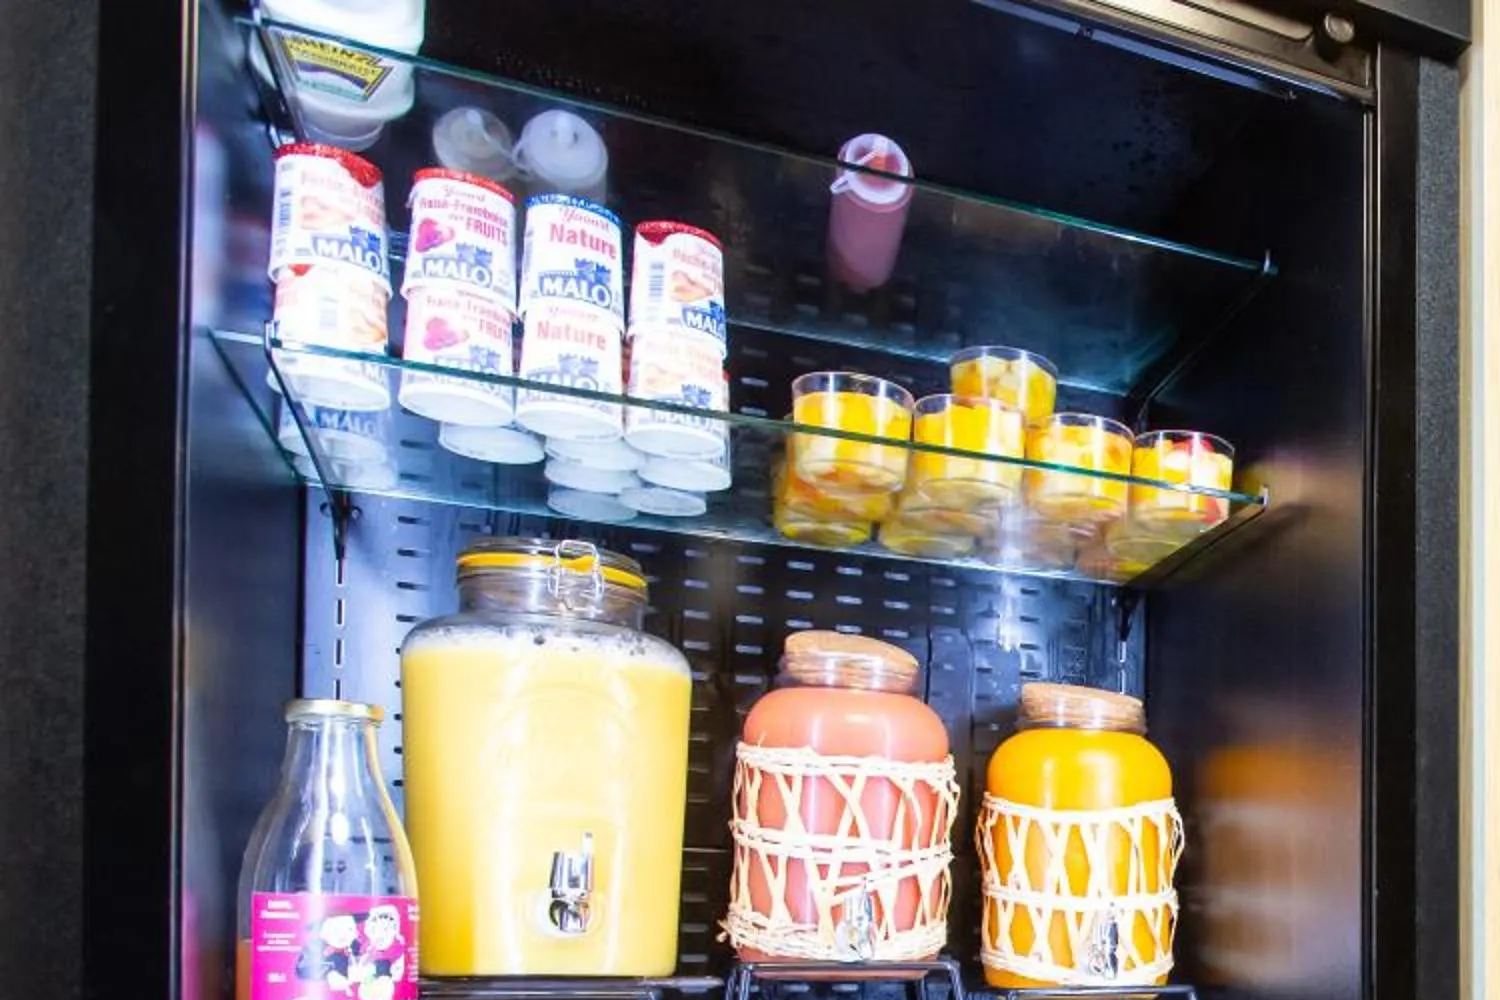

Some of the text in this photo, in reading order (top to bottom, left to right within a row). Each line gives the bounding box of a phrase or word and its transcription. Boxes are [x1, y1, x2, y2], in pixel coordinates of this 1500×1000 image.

[465, 217, 508, 247] FRUITS
[549, 222, 617, 260] Nature
[315, 238, 381, 269] MALO
[425, 259, 490, 287] MALO
[541, 276, 612, 308] MALO
[537, 320, 606, 352] Nature
